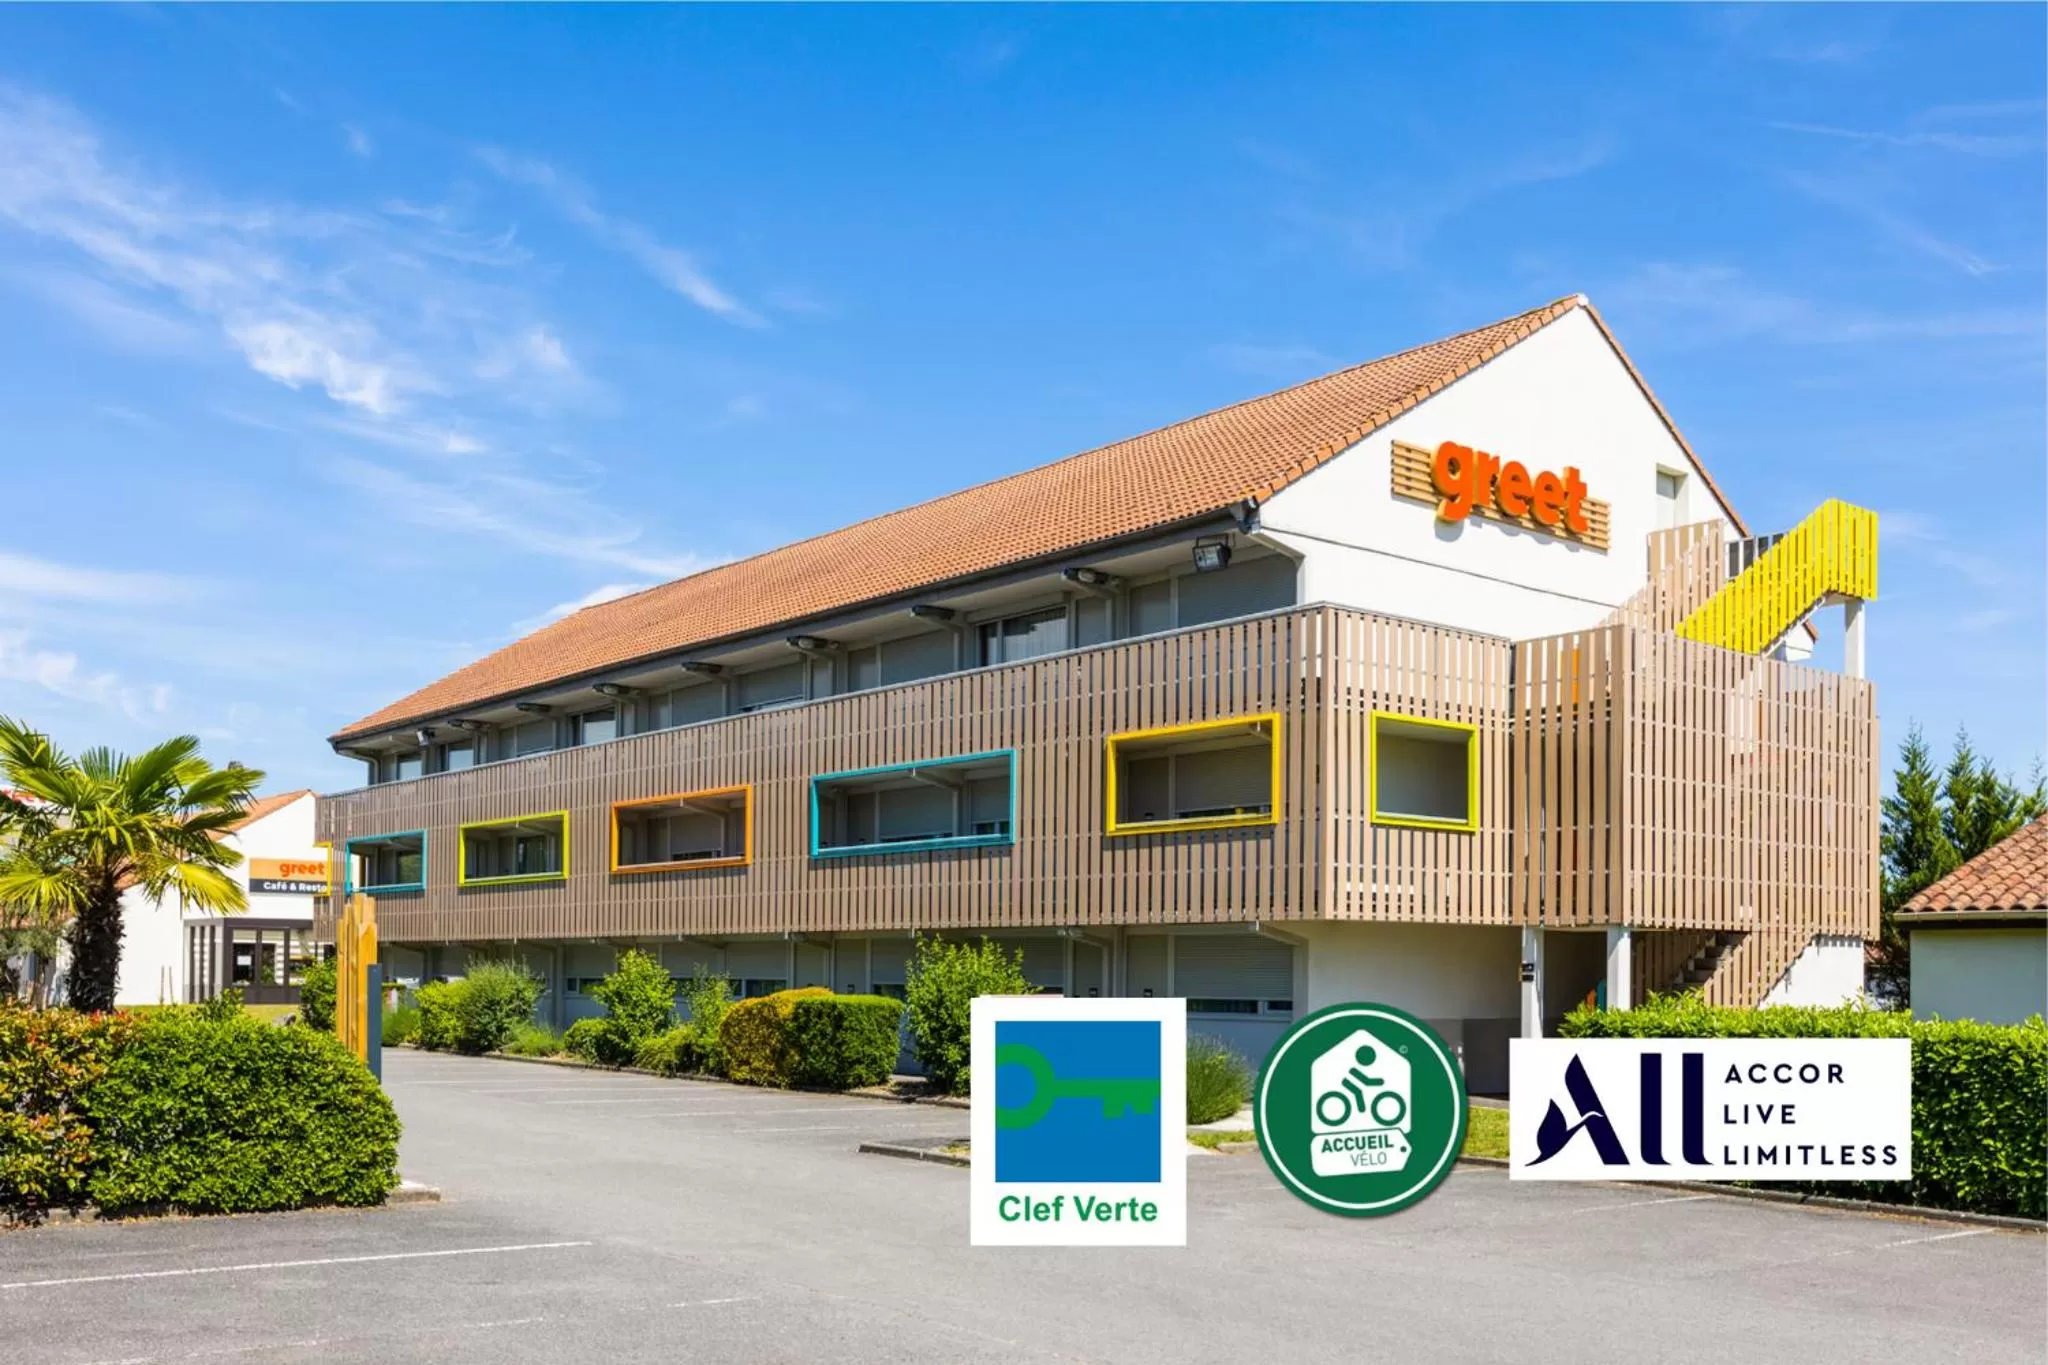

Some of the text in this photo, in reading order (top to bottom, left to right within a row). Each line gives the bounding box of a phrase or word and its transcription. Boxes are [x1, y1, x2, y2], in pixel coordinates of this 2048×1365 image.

[1431, 441, 1588, 533] greet
[279, 863, 325, 877] greet
[263, 881, 287, 890] Café
[289, 882, 297, 891] &
